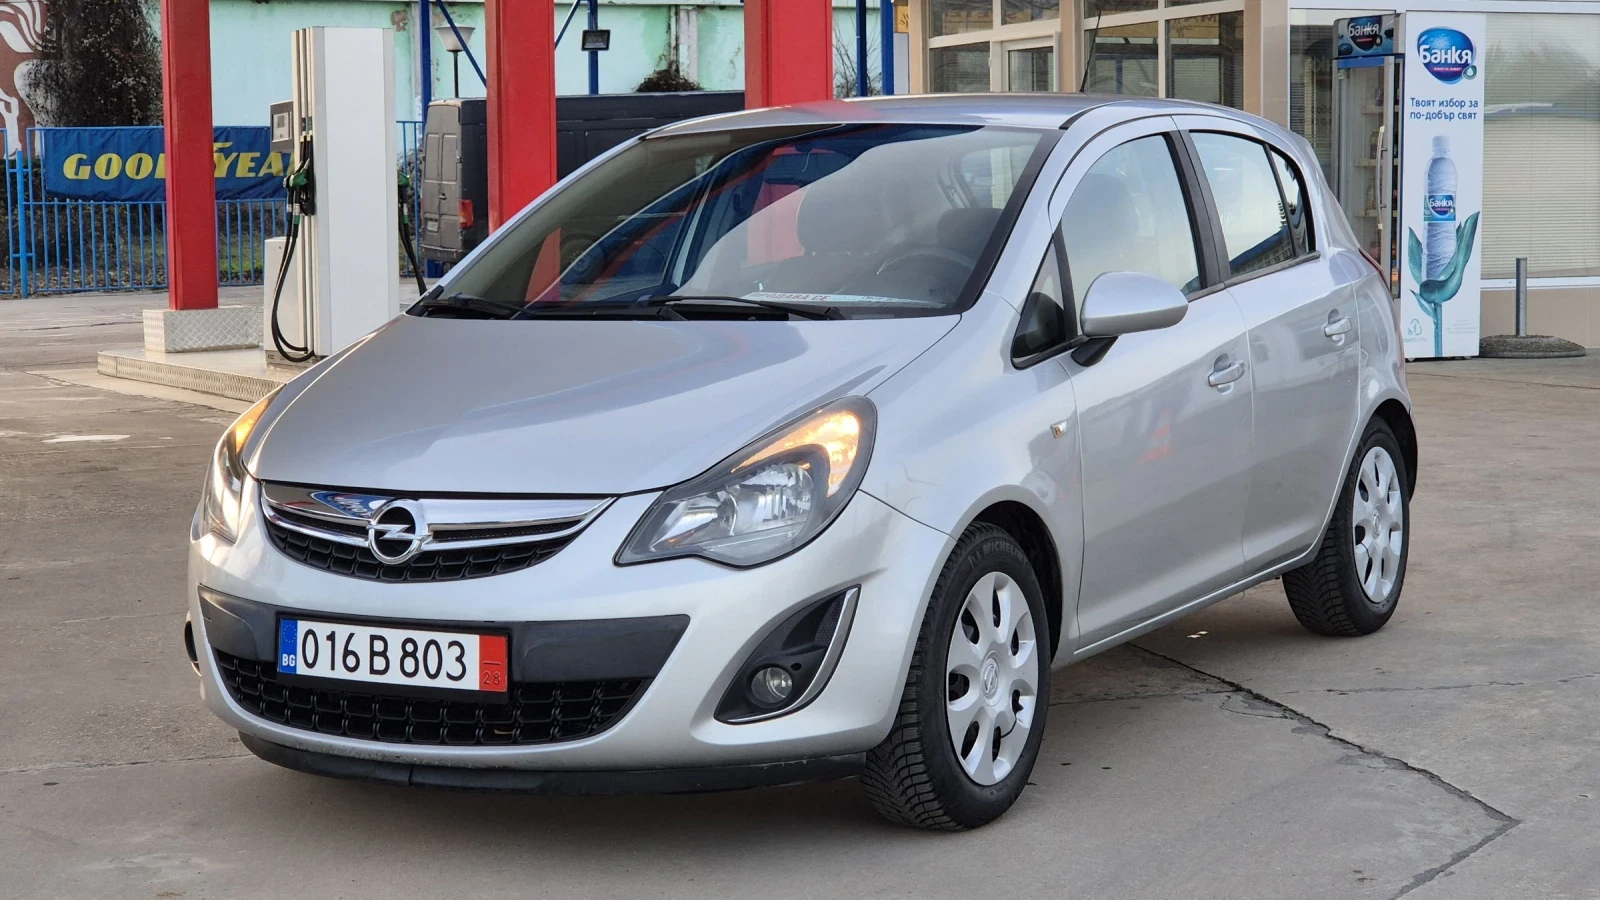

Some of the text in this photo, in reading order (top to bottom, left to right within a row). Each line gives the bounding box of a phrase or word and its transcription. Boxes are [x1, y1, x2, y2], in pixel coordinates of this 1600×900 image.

[1410, 97, 1436, 107] Твоят
[1438, 98, 1466, 109] избор
[1410, 110, 1477, 122] по-добър свят
[63, 152, 295, 180] GOOYEA
[282, 654, 296, 667] BG
[483, 671, 501, 686] 28
